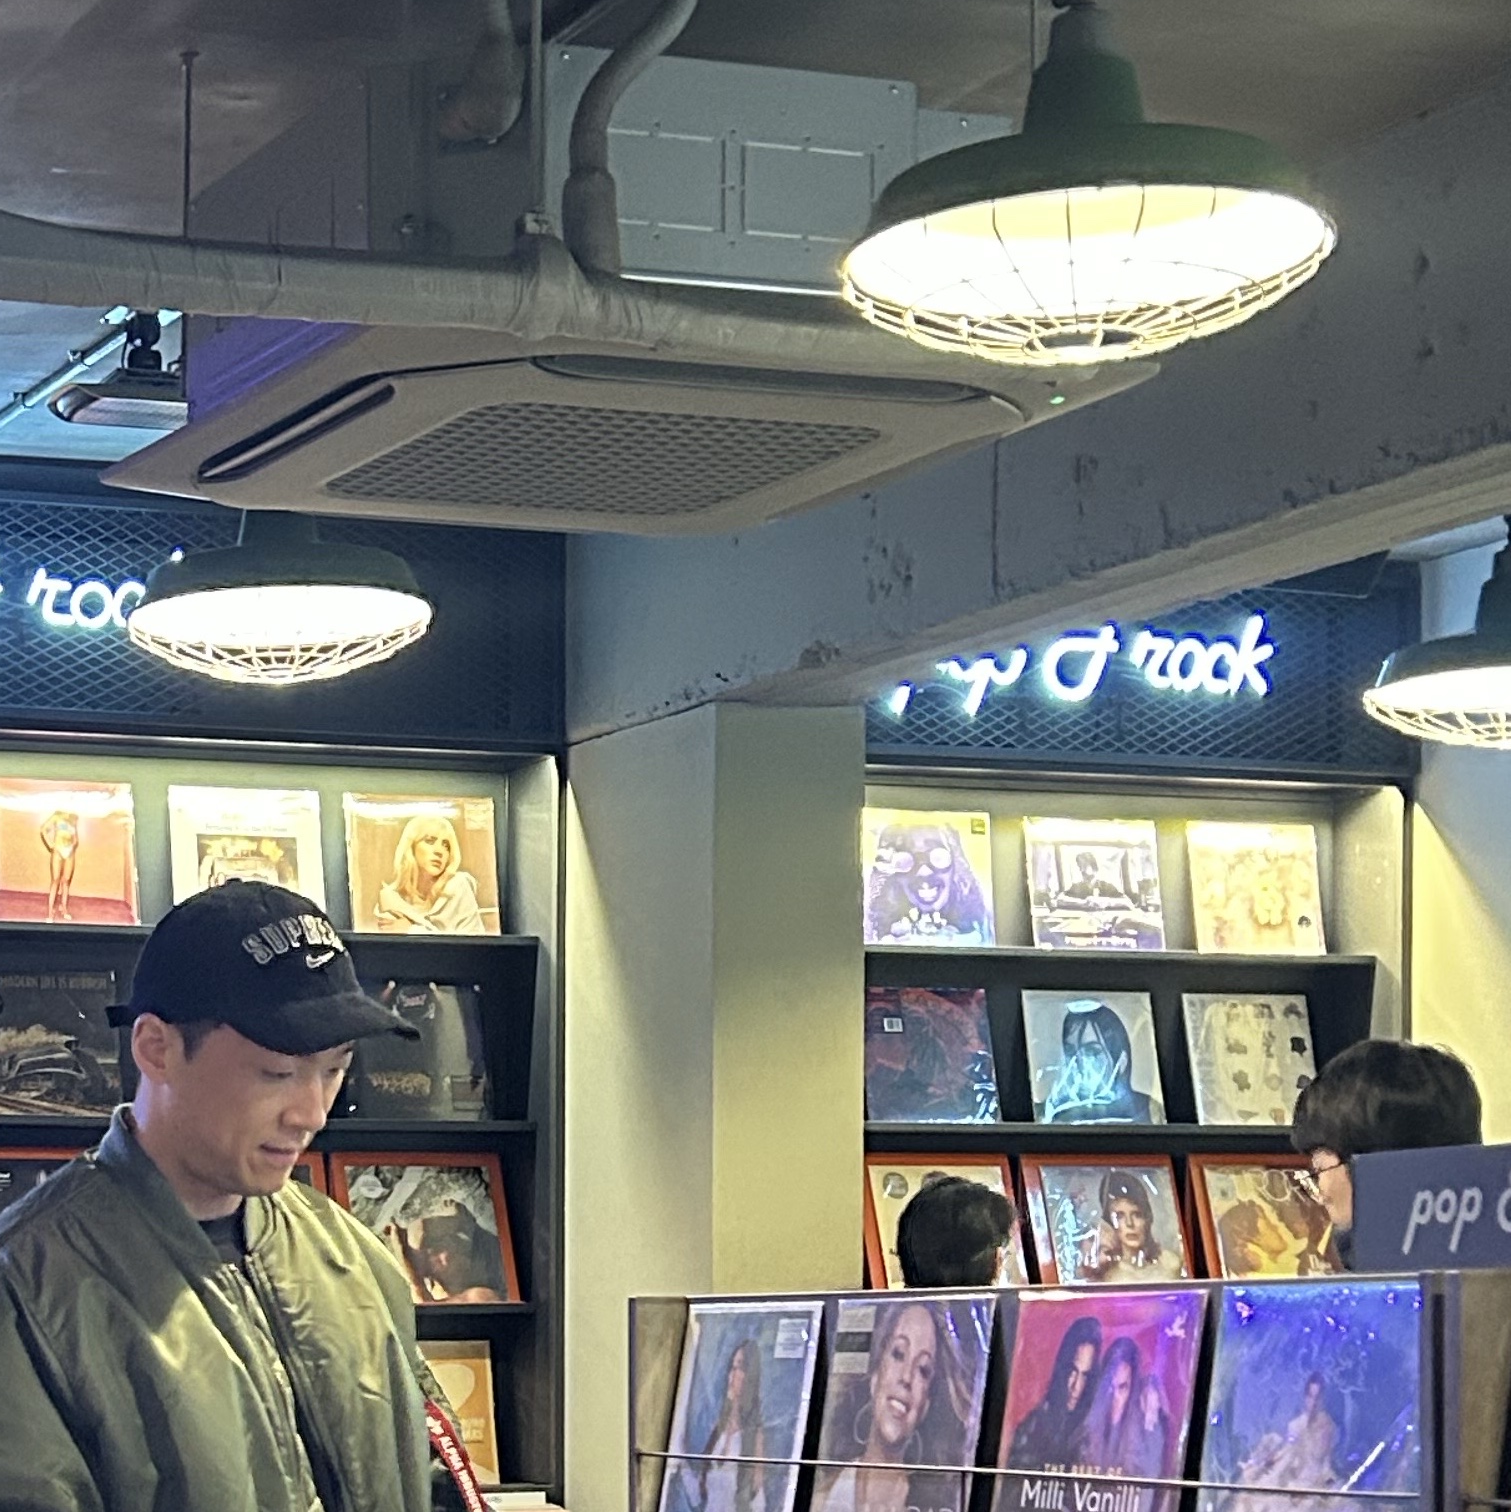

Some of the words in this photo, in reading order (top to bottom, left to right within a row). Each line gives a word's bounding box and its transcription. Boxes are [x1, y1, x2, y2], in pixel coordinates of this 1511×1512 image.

[26, 552, 178, 630] roc
[1132, 611, 1277, 697] rock
[1401, 1185, 1483, 1255] pop
[1020, 1478, 1066, 1511] Milli
